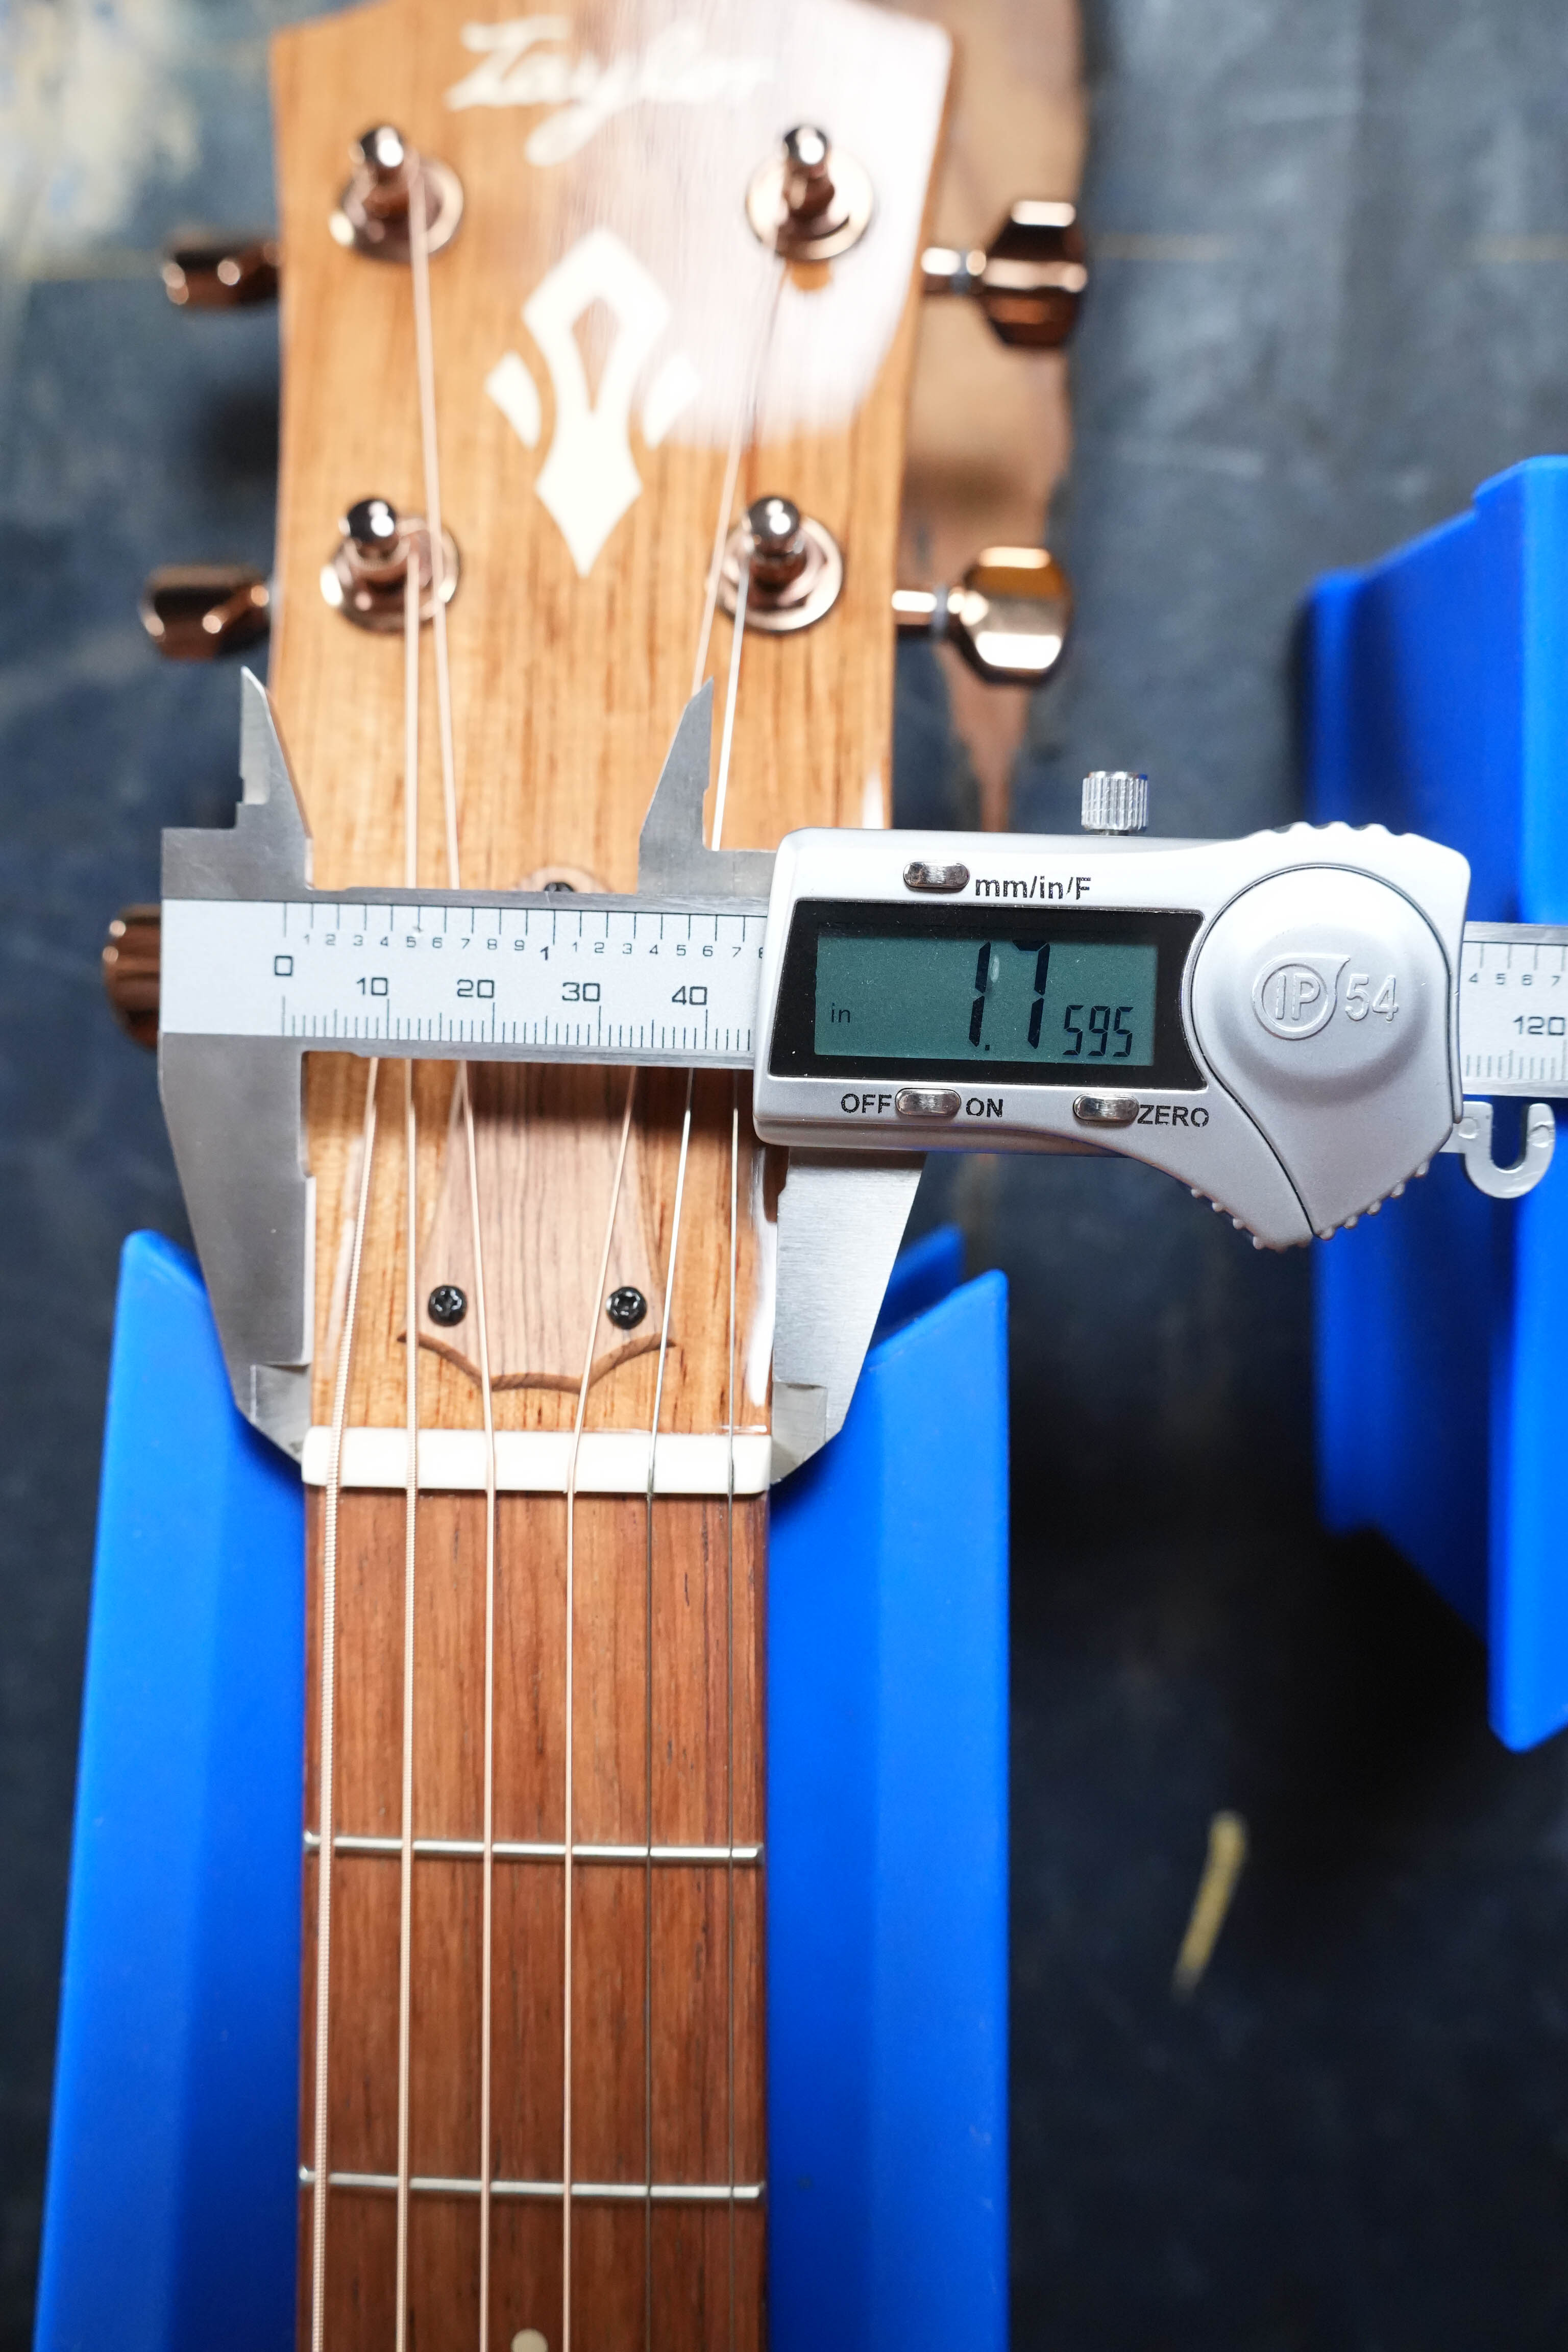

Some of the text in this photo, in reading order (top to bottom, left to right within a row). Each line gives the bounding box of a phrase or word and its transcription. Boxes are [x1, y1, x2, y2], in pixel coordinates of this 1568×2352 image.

[975, 876, 1091, 900] mm/in/F
[304, 934, 742, 961] 1 2 3 4 5 6 7 8 9 1 1 2 3 4 5 6 7
[1468, 973, 1561, 986] 4 5 6 7
[356, 977, 389, 997] 10
[456, 978, 495, 999] 20
[561, 982, 601, 1002] 30
[671, 985, 708, 1006] 40
[1275, 972, 1399, 1022] IP 54
[830, 1002, 851, 1024] in
[1513, 1015, 1566, 1036] 120
[841, 1093, 892, 1114] OFF
[966, 1097, 1003, 1118] ON
[1138, 1104, 1210, 1128] ZERO
